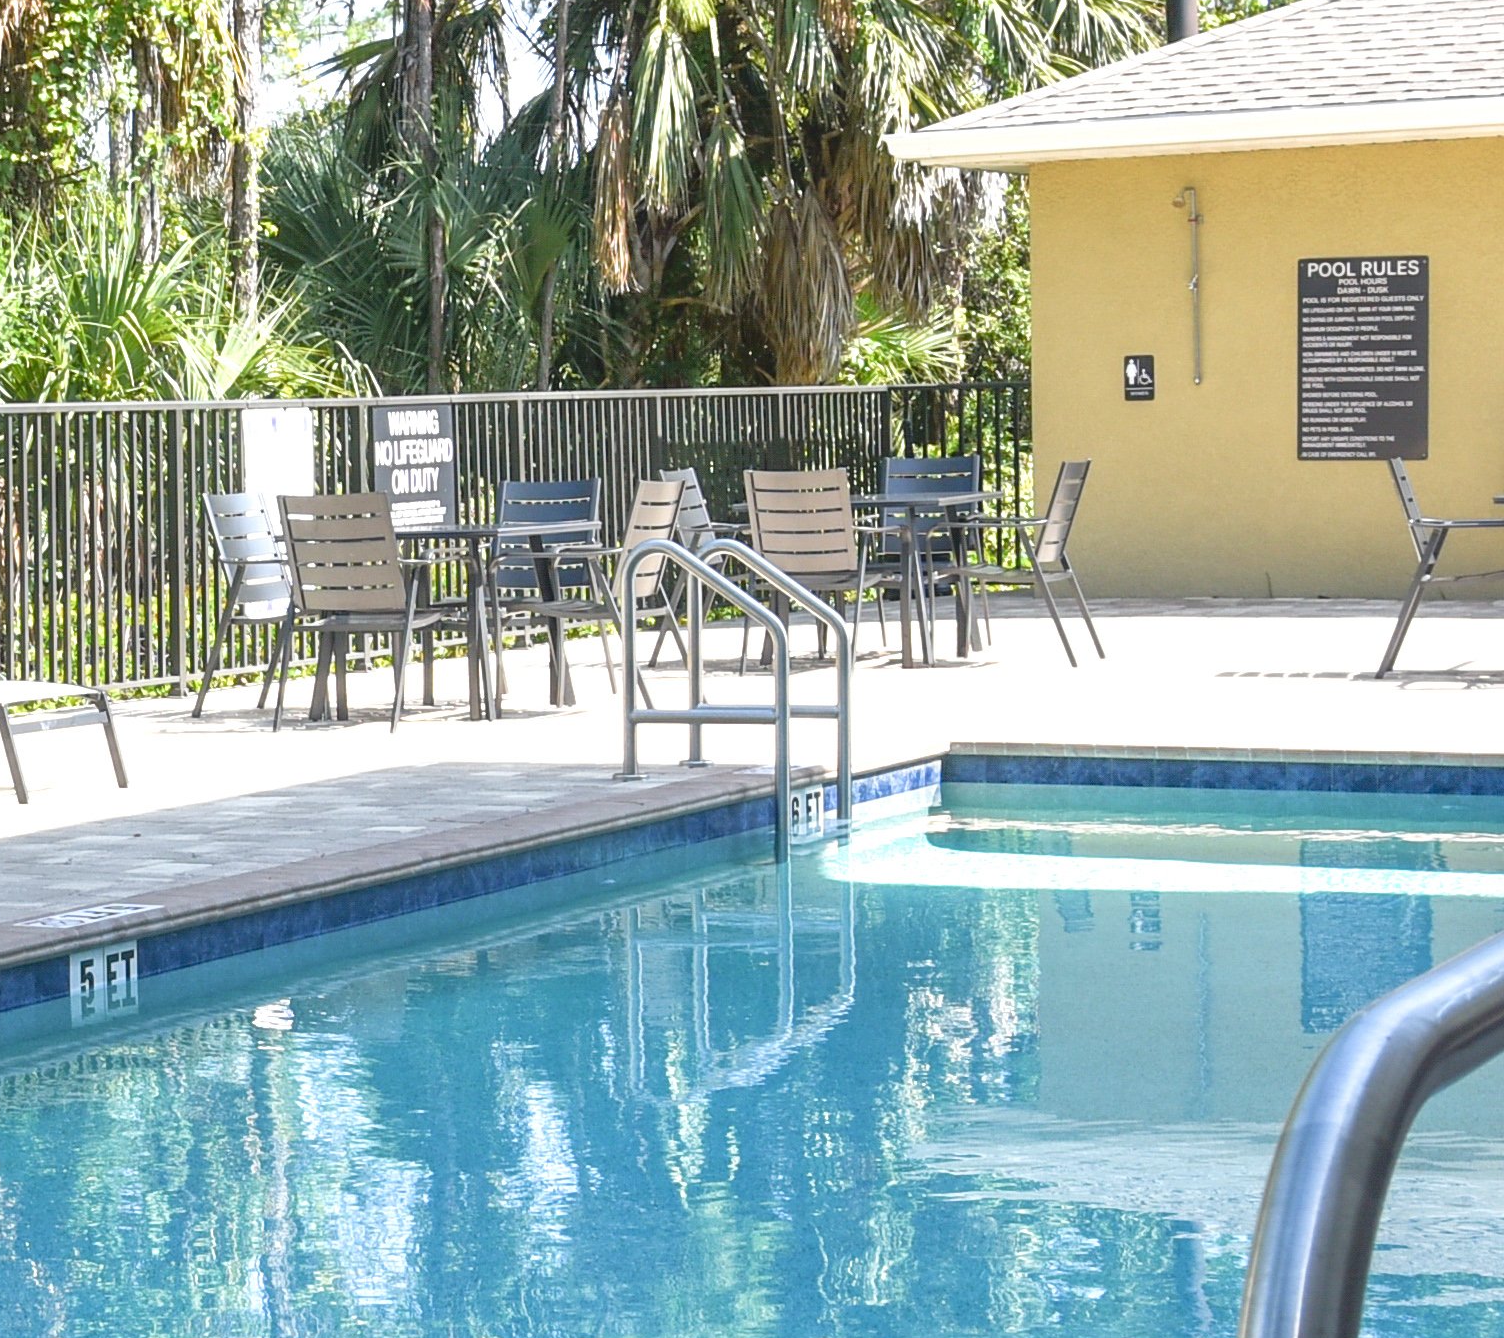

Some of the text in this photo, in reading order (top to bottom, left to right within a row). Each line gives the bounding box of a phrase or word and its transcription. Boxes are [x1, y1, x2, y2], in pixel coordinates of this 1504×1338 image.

[1307, 260, 1419, 277] POOL RULES
[1337, 287, 1361, 295] DAWN
[1367, 286, 1388, 294] DUSK
[1360, 277, 1387, 285] HOURS
[387, 409, 440, 436] WARNING
[375, 438, 453, 466] NO LIFEGUARD
[391, 467, 440, 494] ON DUTY
